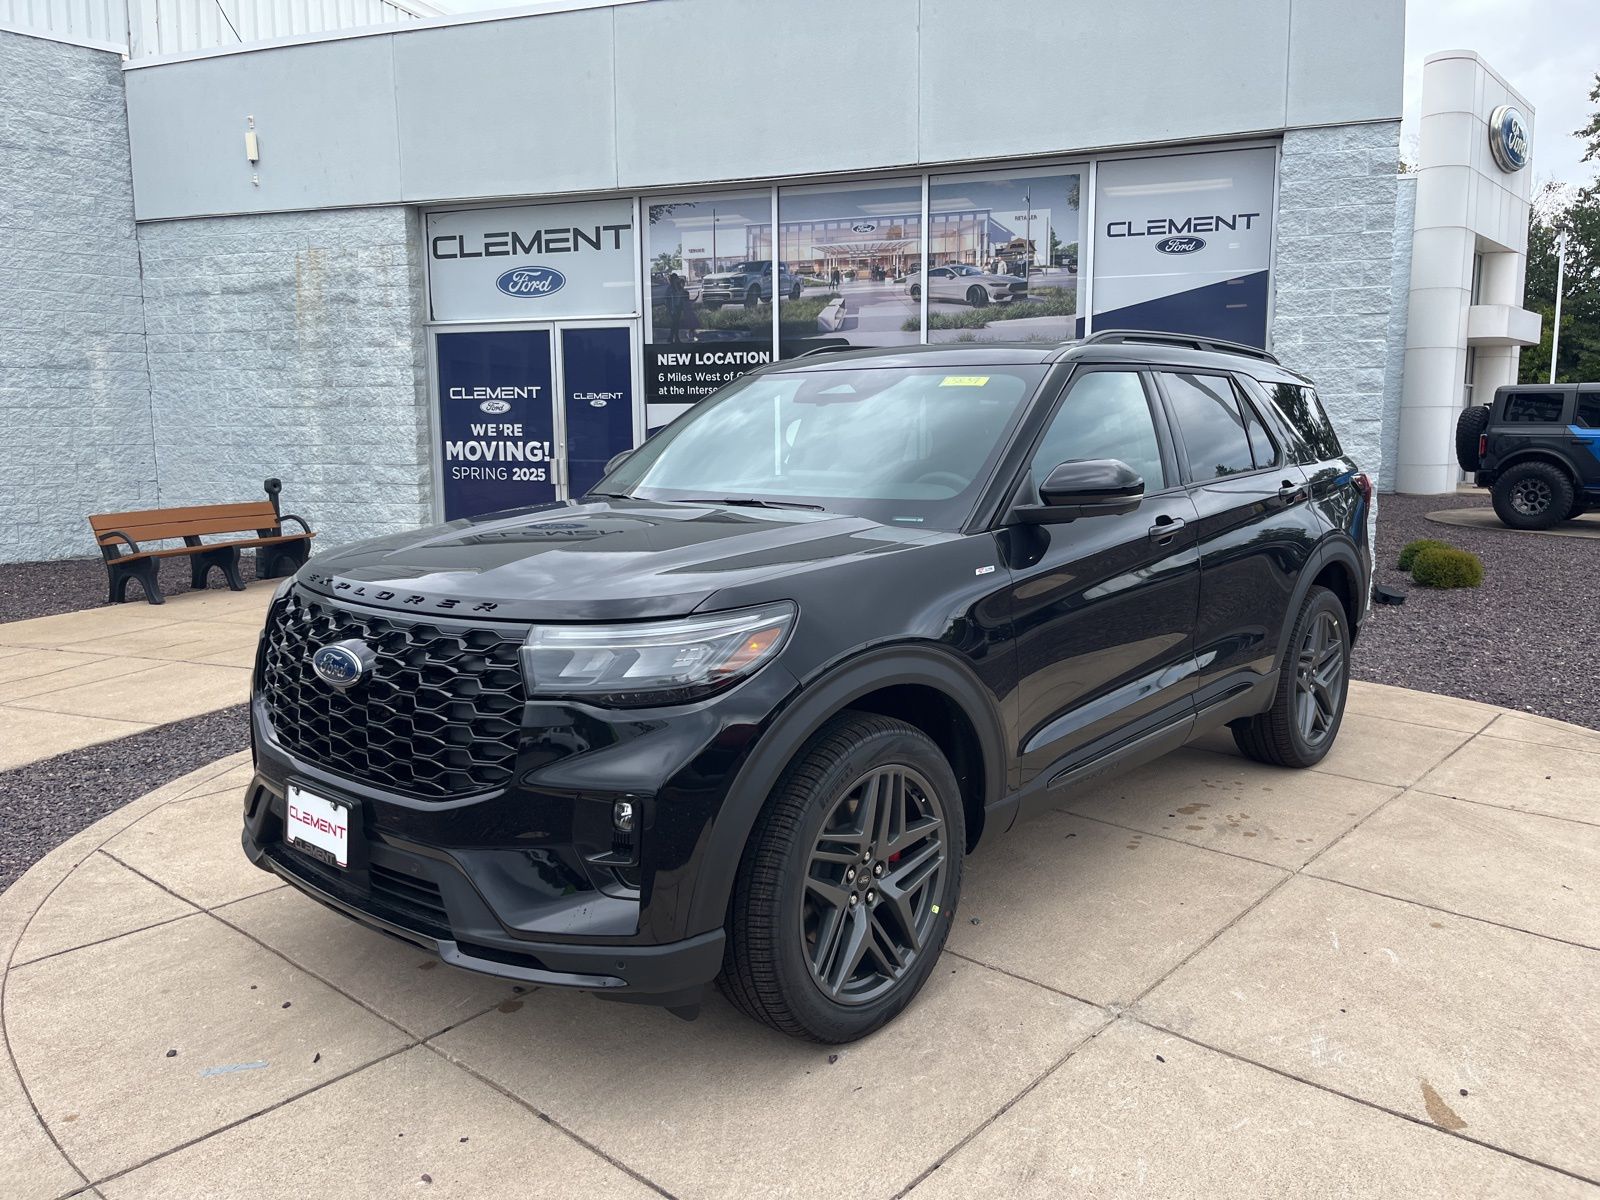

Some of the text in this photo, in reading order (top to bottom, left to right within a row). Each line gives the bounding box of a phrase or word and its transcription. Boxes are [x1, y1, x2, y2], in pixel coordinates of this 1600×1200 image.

[1106, 213, 1260, 238] CLEMENT
[432, 224, 631, 260] CLEMENT
[657, 351, 770, 366] NEW LOCATION
[658, 373, 665, 382] 6
[667, 372, 692, 382] Miles
[695, 372, 721, 382] West
[723, 371, 734, 381] of
[450, 386, 541, 399] CLEMENT
[573, 392, 623, 400] CLEMENT
[658, 387, 668, 395] at
[670, 386, 685, 395] the
[470, 423, 523, 437] WE'RE
[446, 441, 550, 462] MOVING!
[452, 466, 546, 481] SPRING 2025
[308, 574, 498, 612] EXPLORER
[290, 805, 346, 839] CLEMENT
[294, 840, 336, 864] CLEMENT
